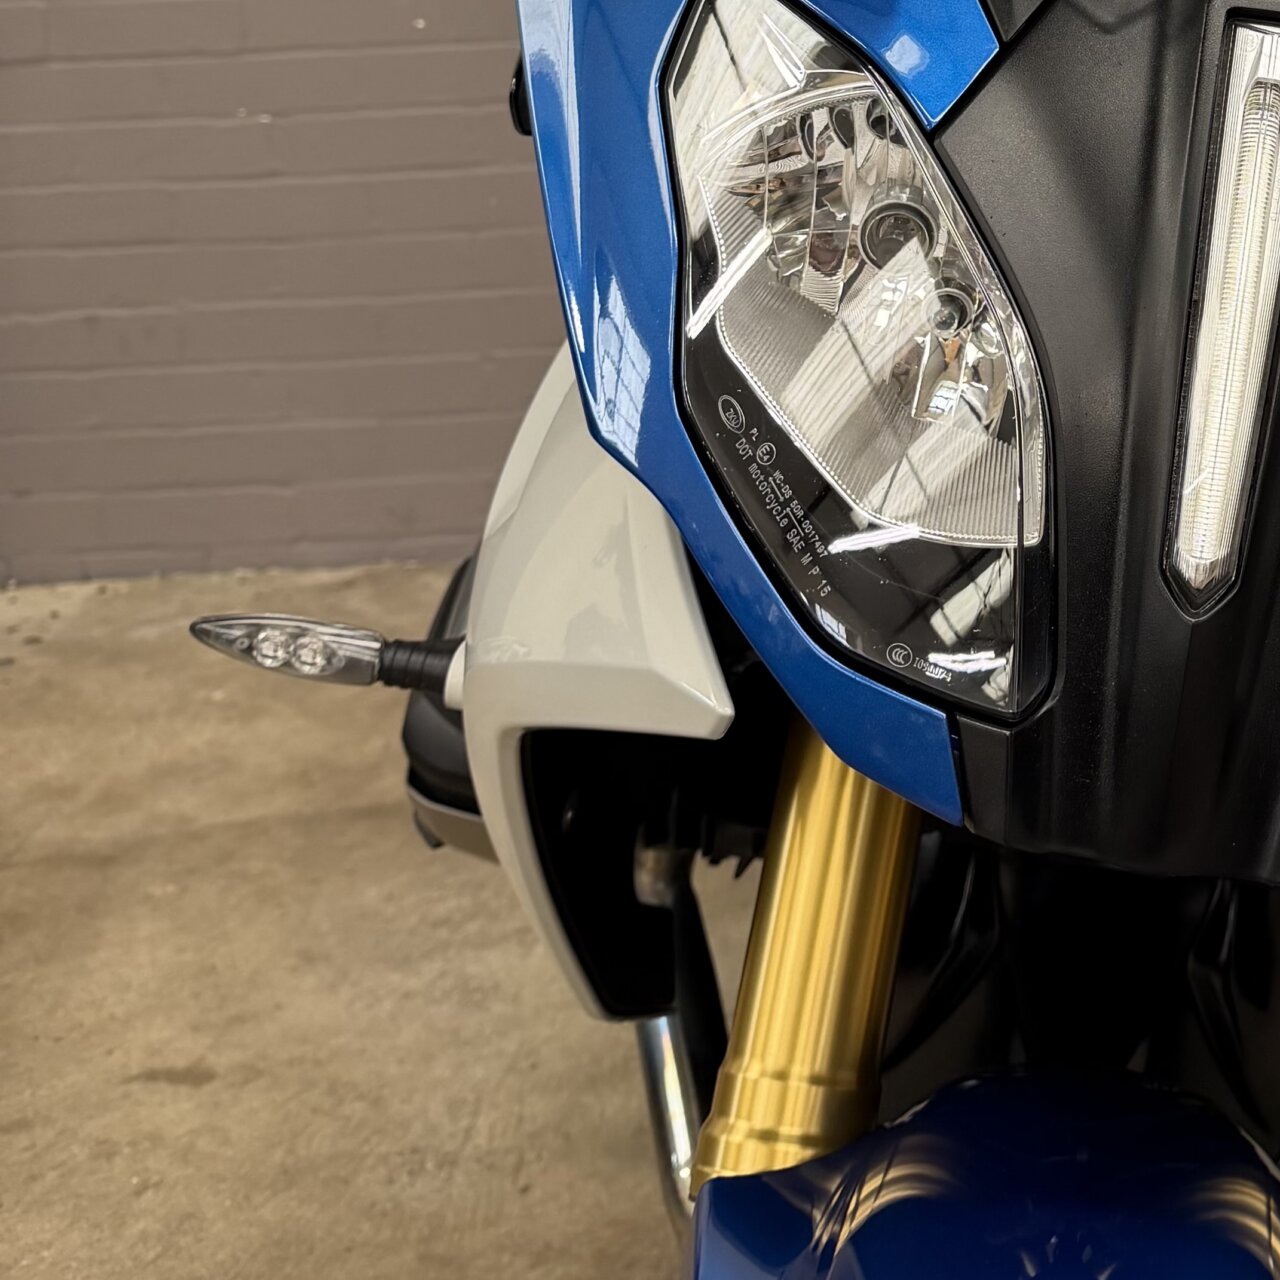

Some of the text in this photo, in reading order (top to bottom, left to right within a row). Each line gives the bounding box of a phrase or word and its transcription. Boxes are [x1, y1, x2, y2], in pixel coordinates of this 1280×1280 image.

[749, 427, 759, 441] PL
[735, 437, 832, 597] DOT motorcycle SAE M P 15
